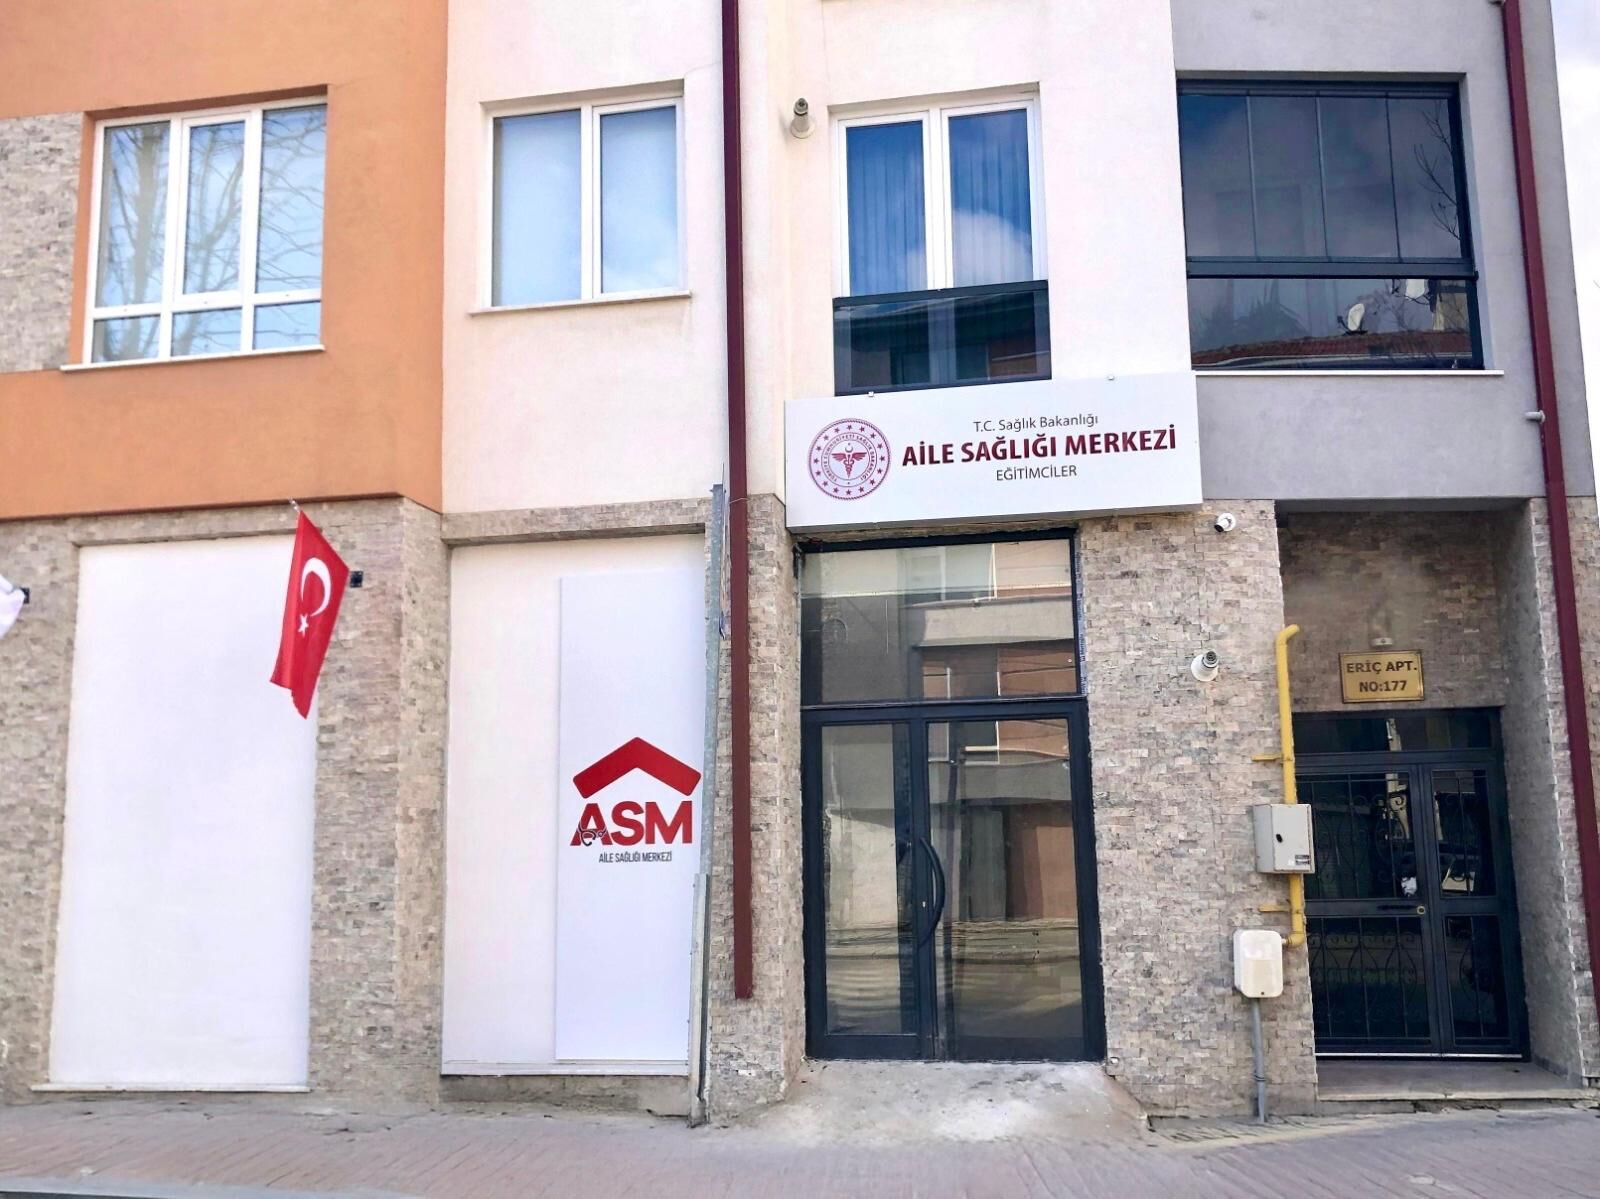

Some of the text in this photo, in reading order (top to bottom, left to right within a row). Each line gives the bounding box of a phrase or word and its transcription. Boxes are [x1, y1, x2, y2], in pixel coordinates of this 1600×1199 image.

[973, 413, 1099, 433] T.C. Sağlık Bakanlığı
[902, 423, 1176, 467] AİLE SAĞLIĞI MERKEZİ
[996, 463, 1078, 481] EĞİTİMCİLER
[1346, 660, 1418, 675] ERİÇ APT.
[1359, 680, 1407, 693] NO:177
[570, 800, 693, 846] ASM
[598, 850, 673, 863] AİLE SAĞLIĞI MERKEZİ
